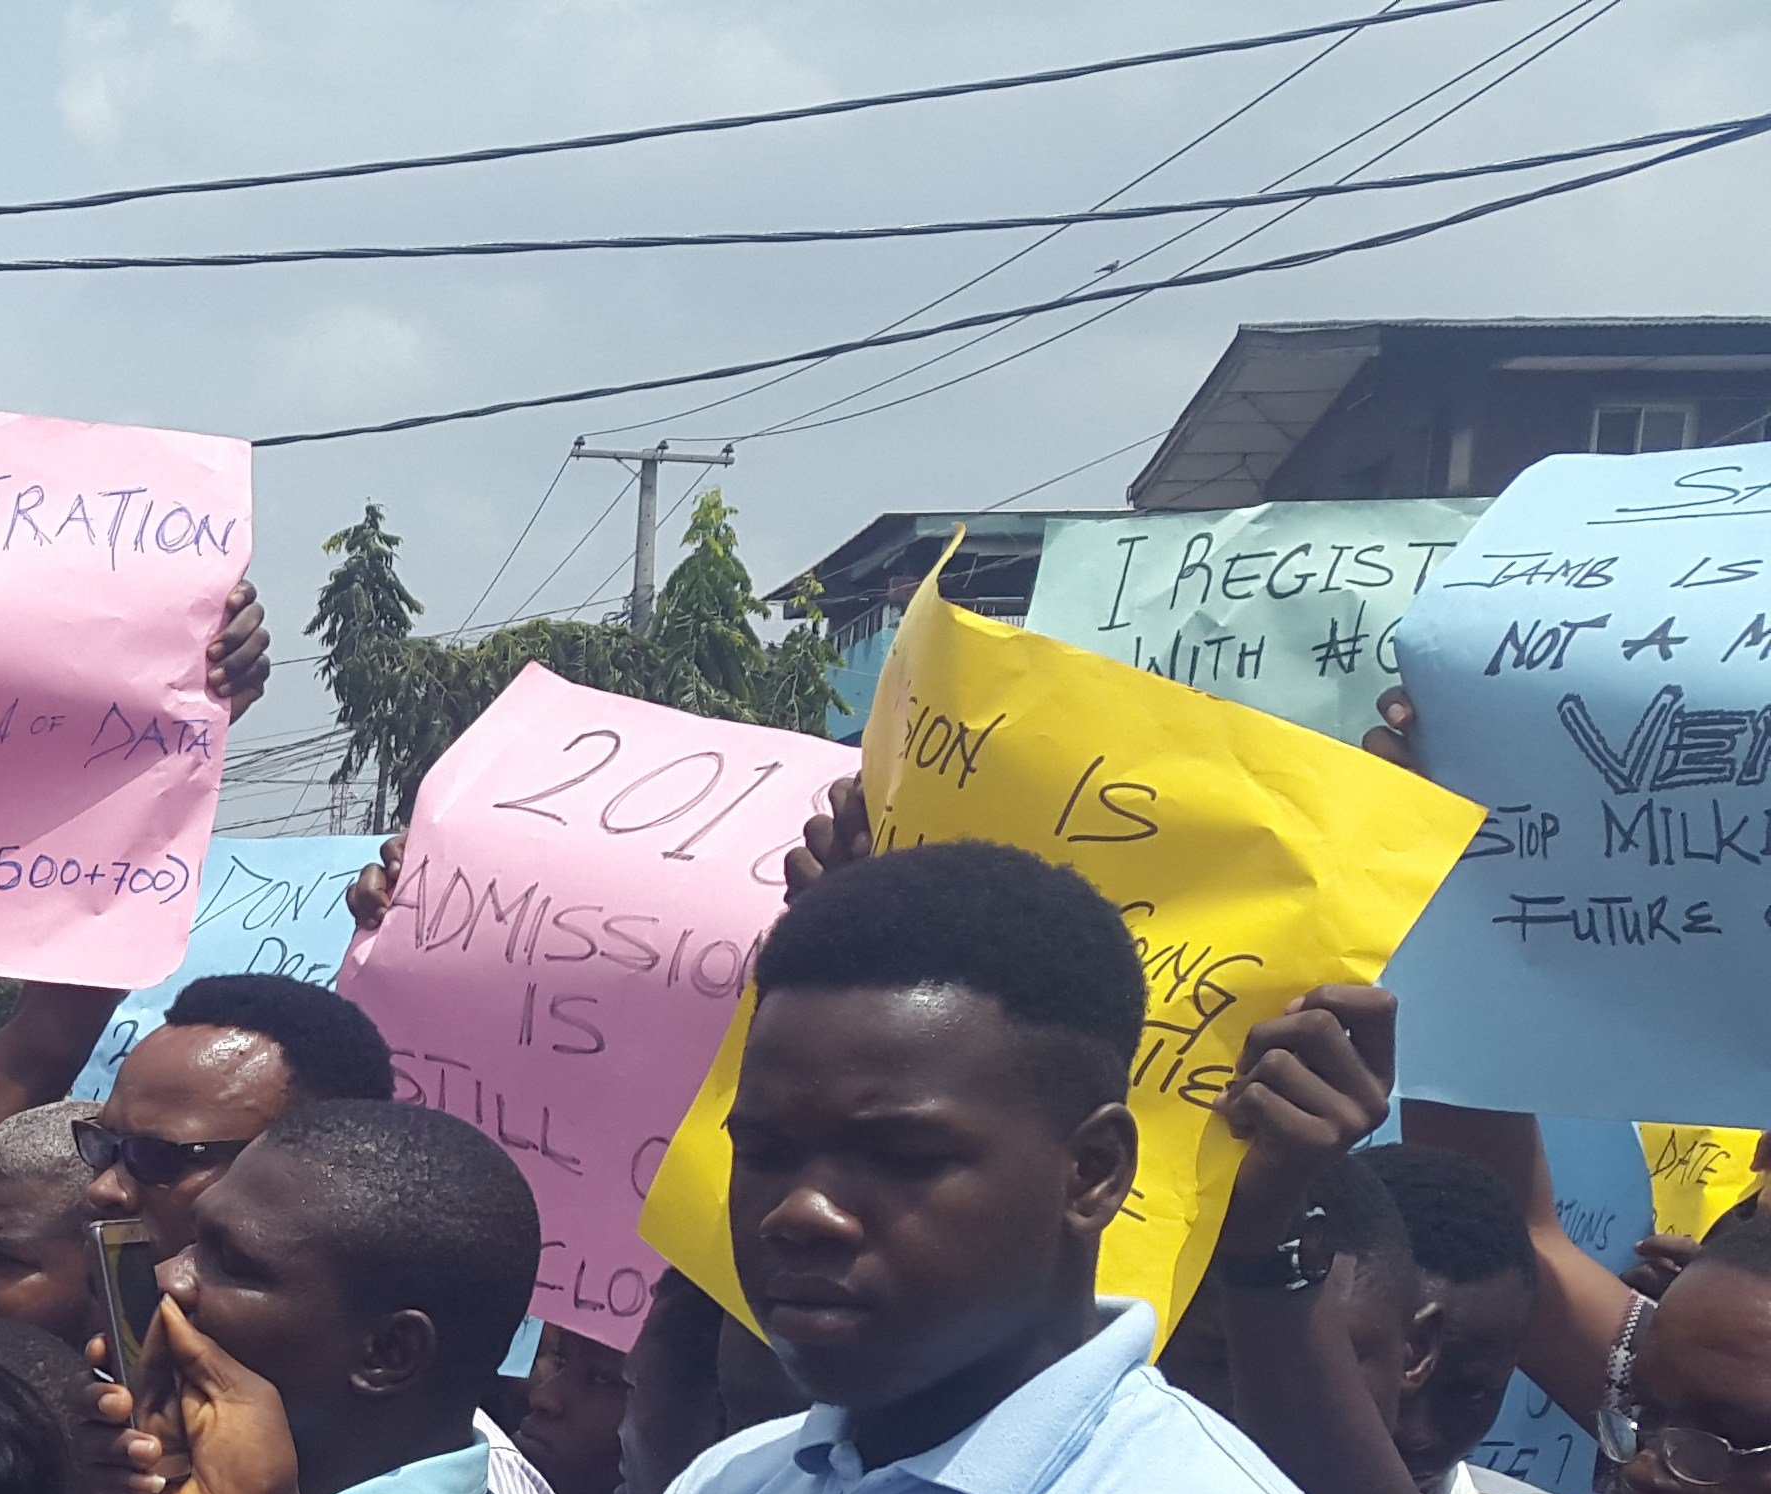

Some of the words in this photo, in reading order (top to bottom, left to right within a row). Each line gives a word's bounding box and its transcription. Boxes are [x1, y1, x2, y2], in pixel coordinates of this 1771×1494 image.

[1097, 535, 1150, 632] I
[1169, 531, 1458, 610] REGIST
[1443, 551, 1619, 589] JAMB
[1670, 557, 1764, 589] IS
[1485, 612, 1613, 677] NOT
[1621, 616, 1689, 662] A
[29, 713, 68, 736] OF
[83, 699, 213, 770] DATA
[493, 728, 861, 887] 201
[897, 711, 1008, 789] ION
[1055, 755, 1159, 843] IS
[1459, 803, 1560, 862] STOP
[1602, 798, 1771, 867] MILK
[1491, 894, 1723, 946] FUTURE
[516, 981, 607, 1054] IS
[1649, 1128, 1733, 1187] DATE
